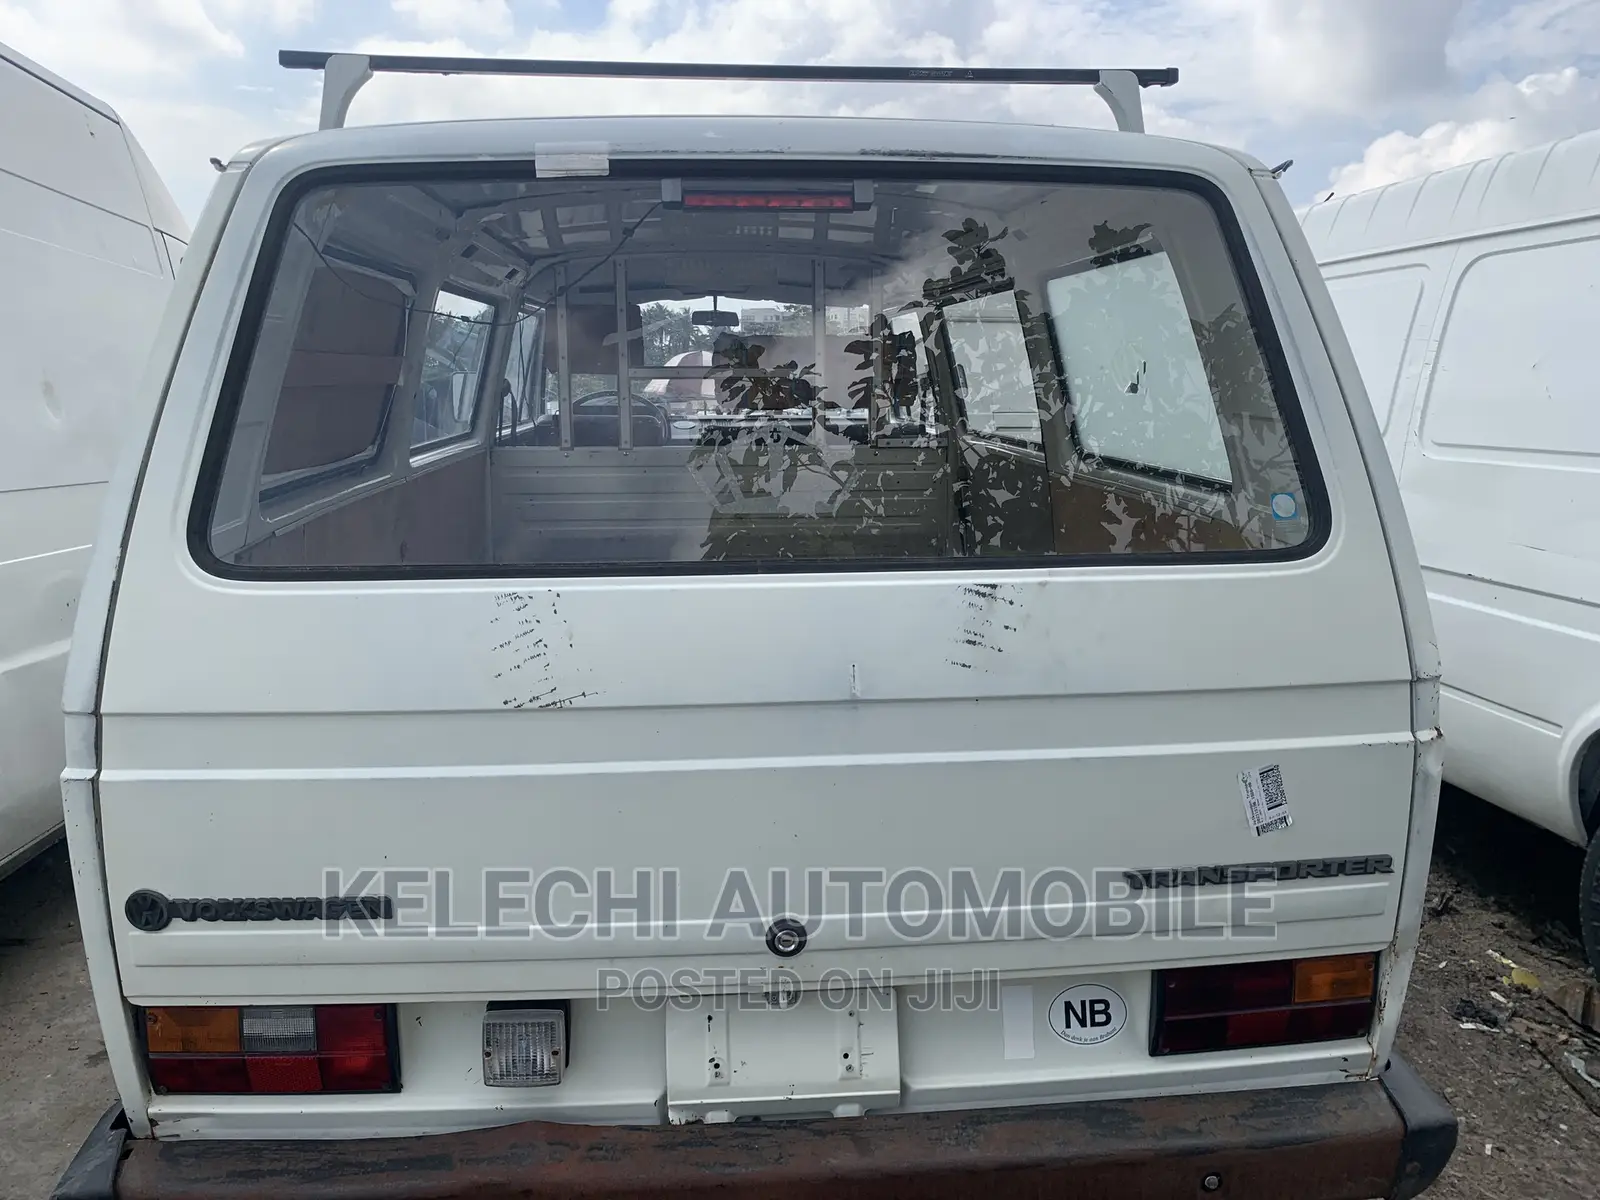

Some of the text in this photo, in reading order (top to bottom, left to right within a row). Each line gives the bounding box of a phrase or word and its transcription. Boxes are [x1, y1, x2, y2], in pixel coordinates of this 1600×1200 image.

[1122, 853, 1394, 889] TRANSPORTER
[172, 896, 392, 922] VOLKSWAGEN
[1064, 999, 1112, 1029] NB
[1060, 1030, 1070, 1038] Dan
[1100, 1027, 1117, 1039] Brabant
